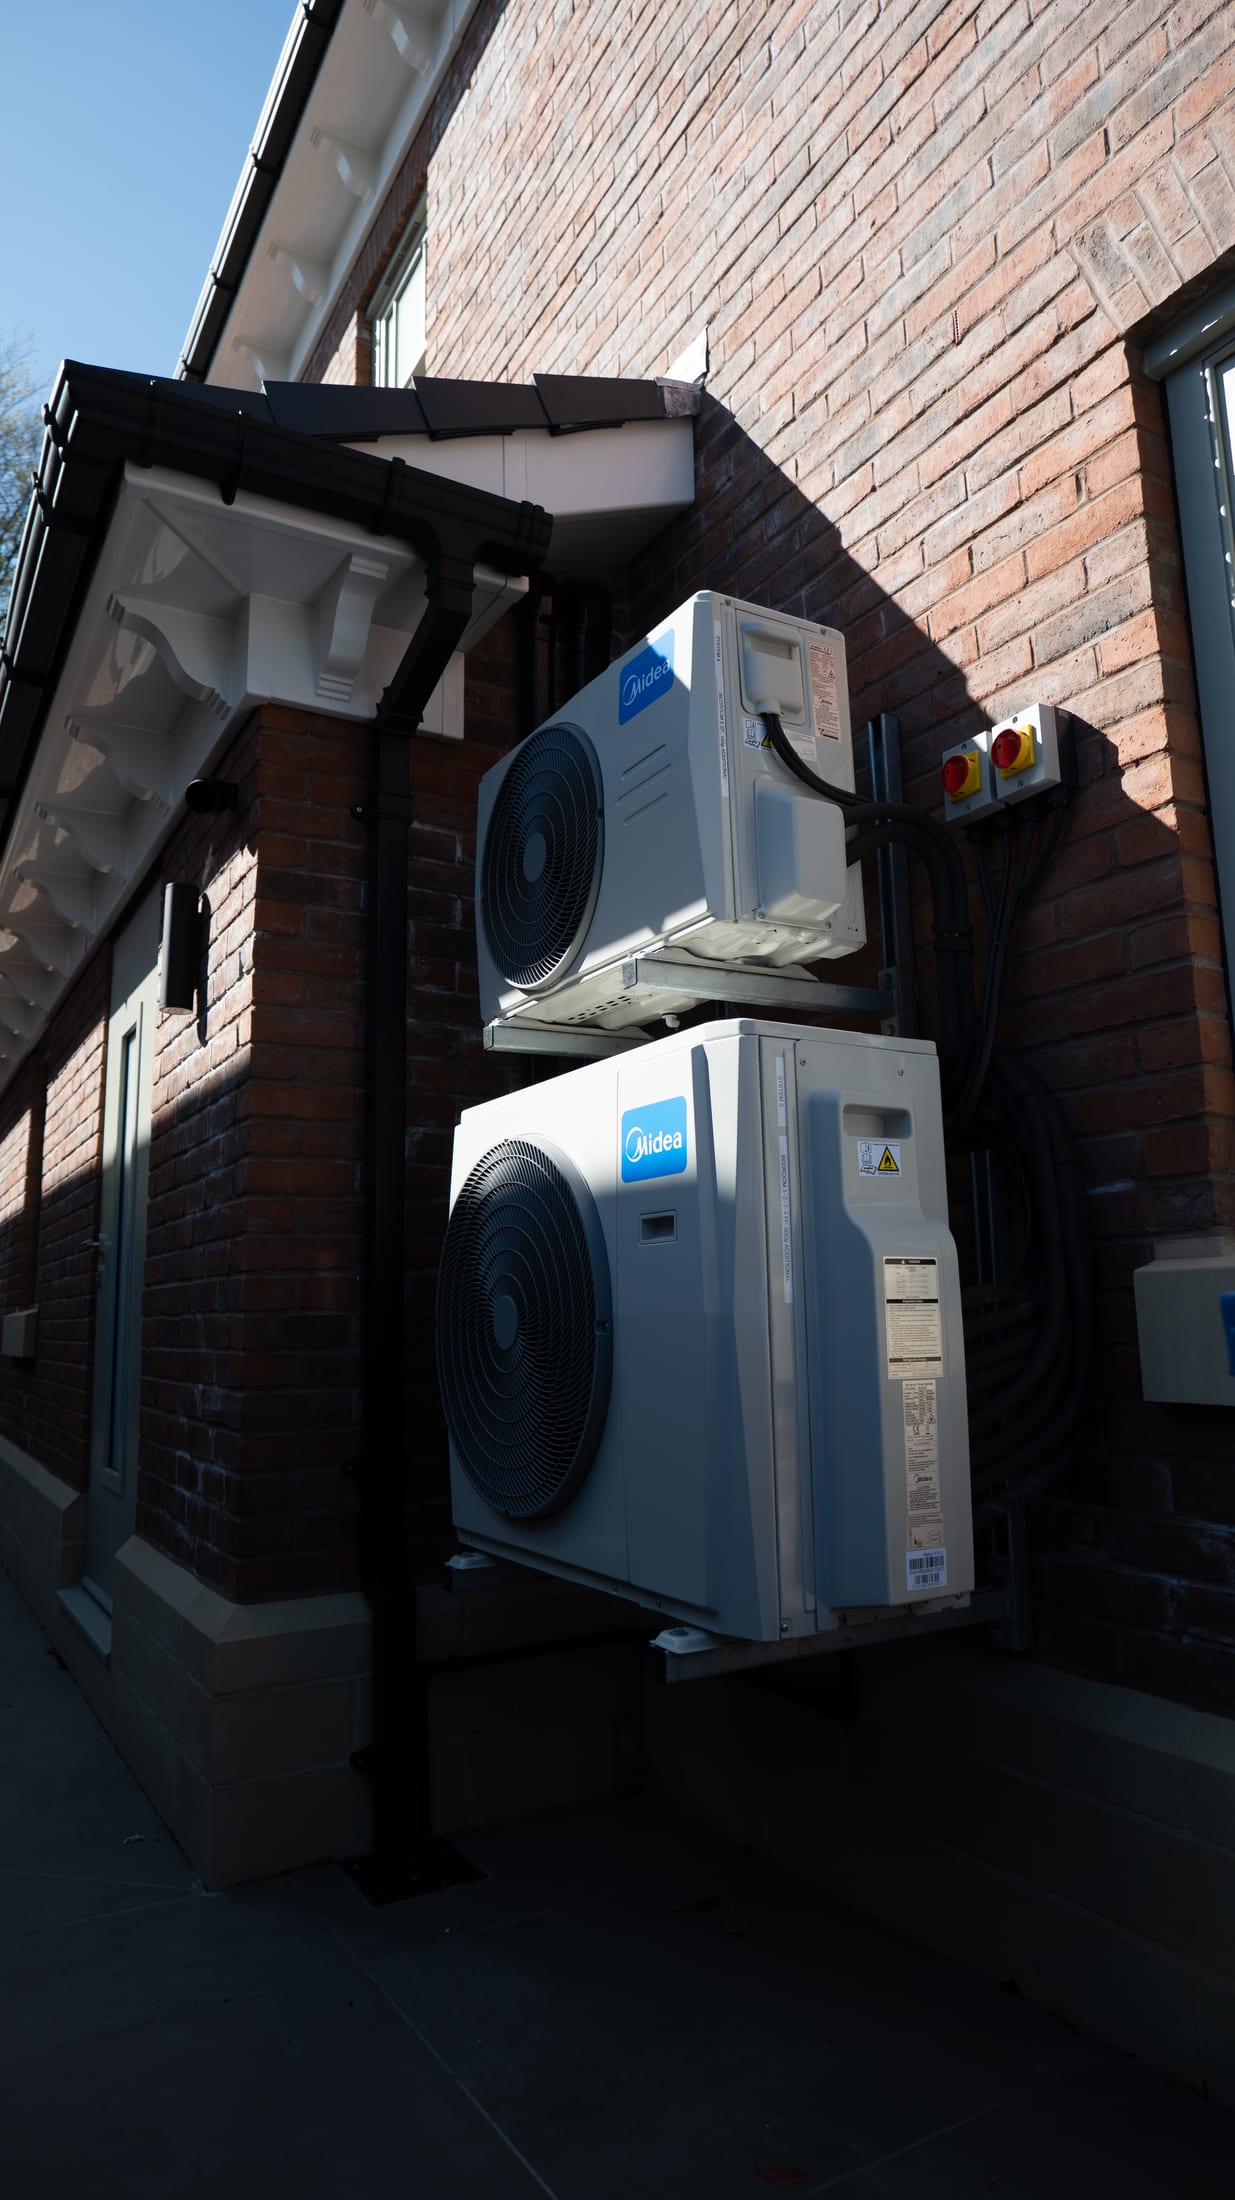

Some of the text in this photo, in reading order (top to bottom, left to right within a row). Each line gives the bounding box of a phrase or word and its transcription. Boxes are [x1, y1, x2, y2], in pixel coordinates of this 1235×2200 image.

[623, 659, 670, 706] Midea
[626, 1126, 682, 1163] Midea
[913, 1474, 933, 1484] Midea
